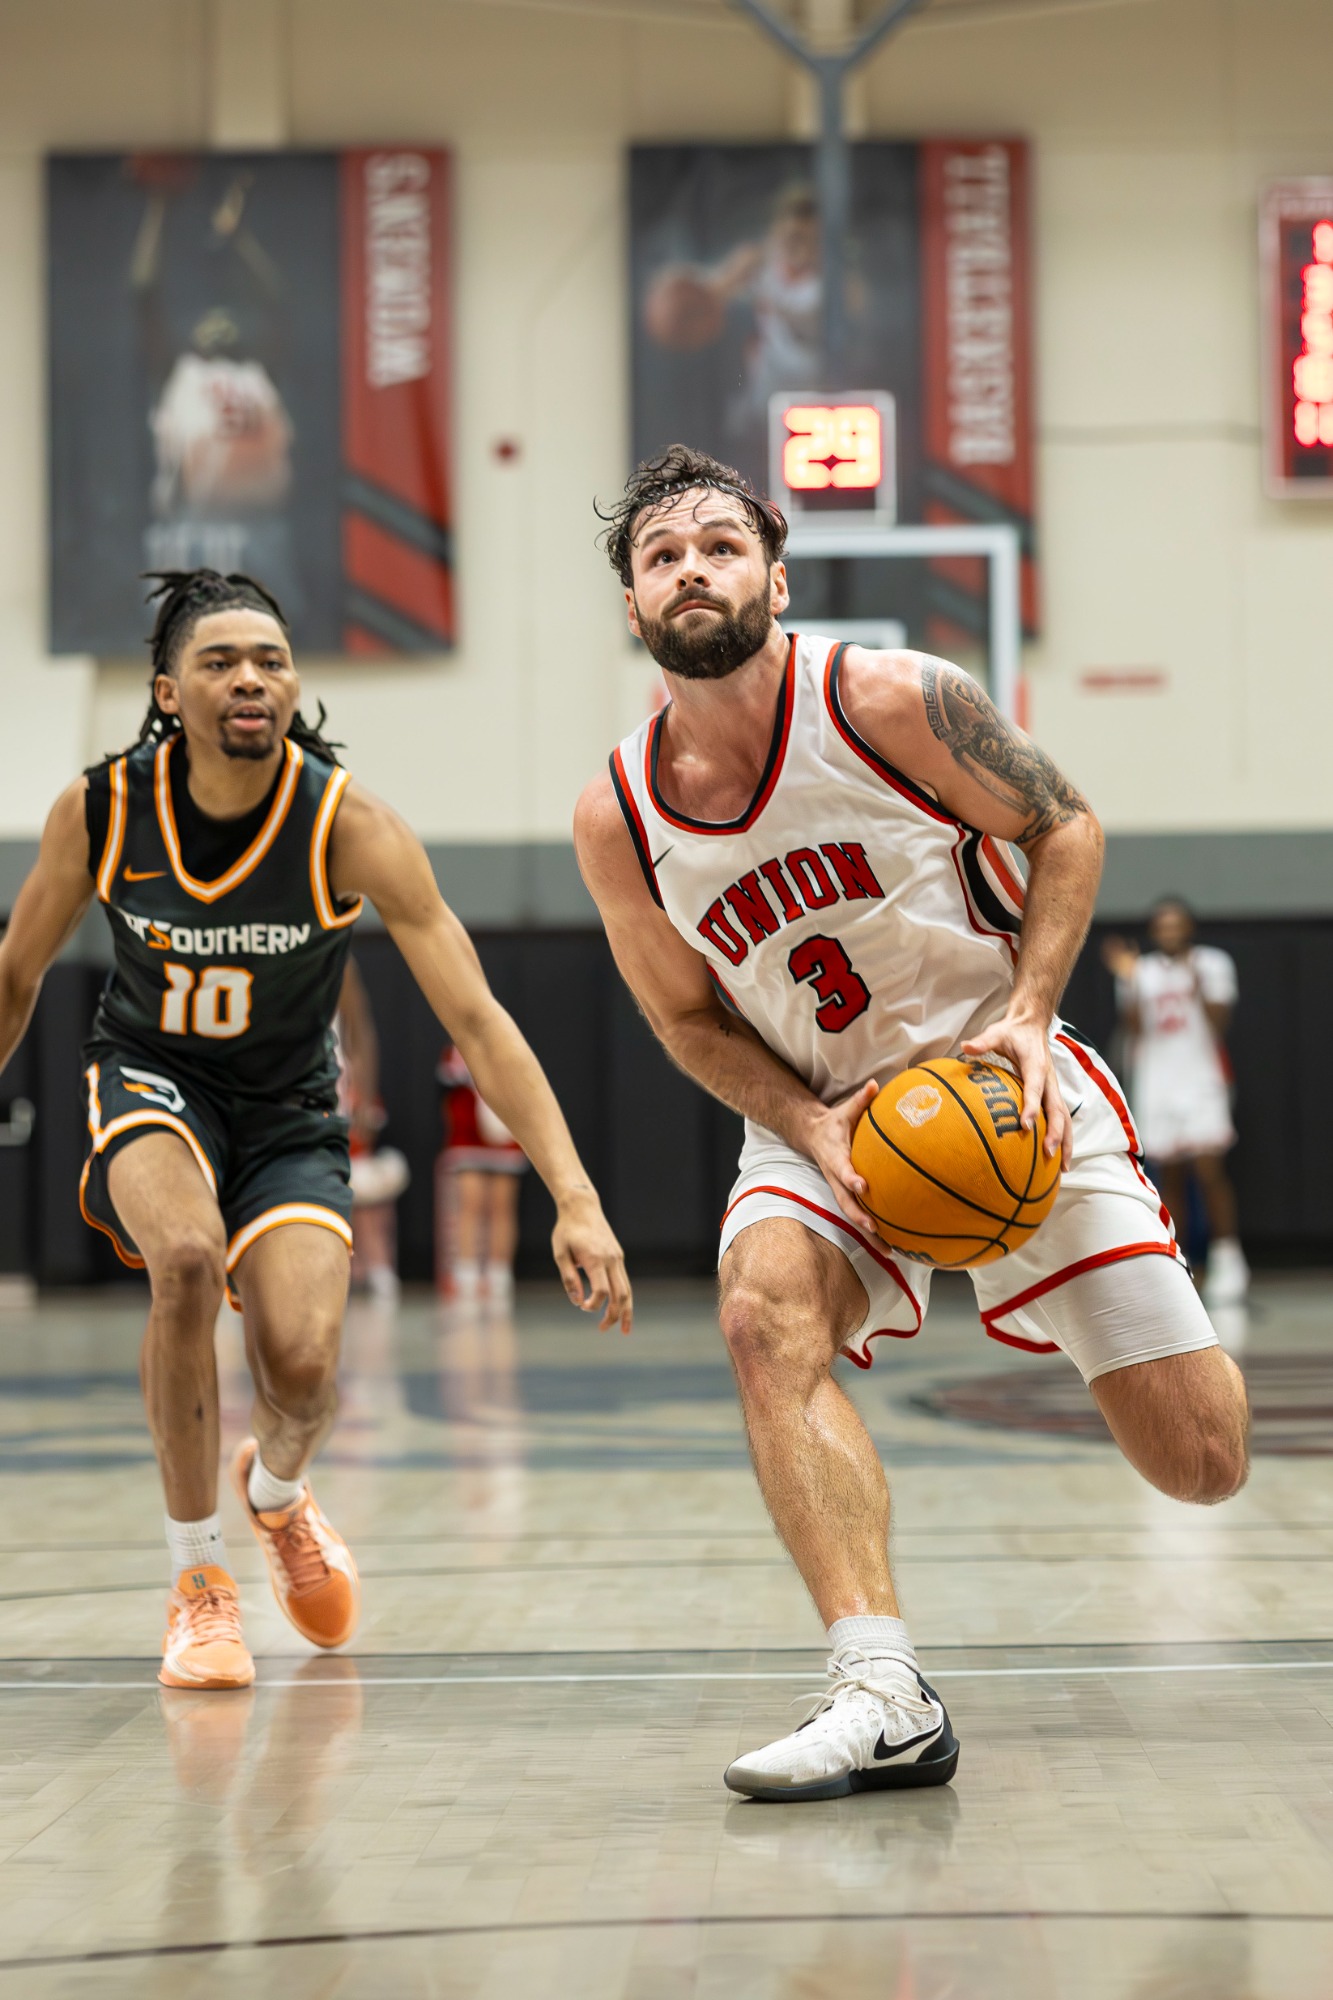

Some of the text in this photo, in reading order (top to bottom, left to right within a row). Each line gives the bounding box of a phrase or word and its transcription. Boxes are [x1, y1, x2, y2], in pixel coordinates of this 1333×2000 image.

[945, 147, 1014, 464] BASKETBALL
[783, 406, 881, 490] 29
[696, 842, 886, 967] UNION
[159, 961, 254, 1040] 10
[788, 933, 872, 1034] 3
